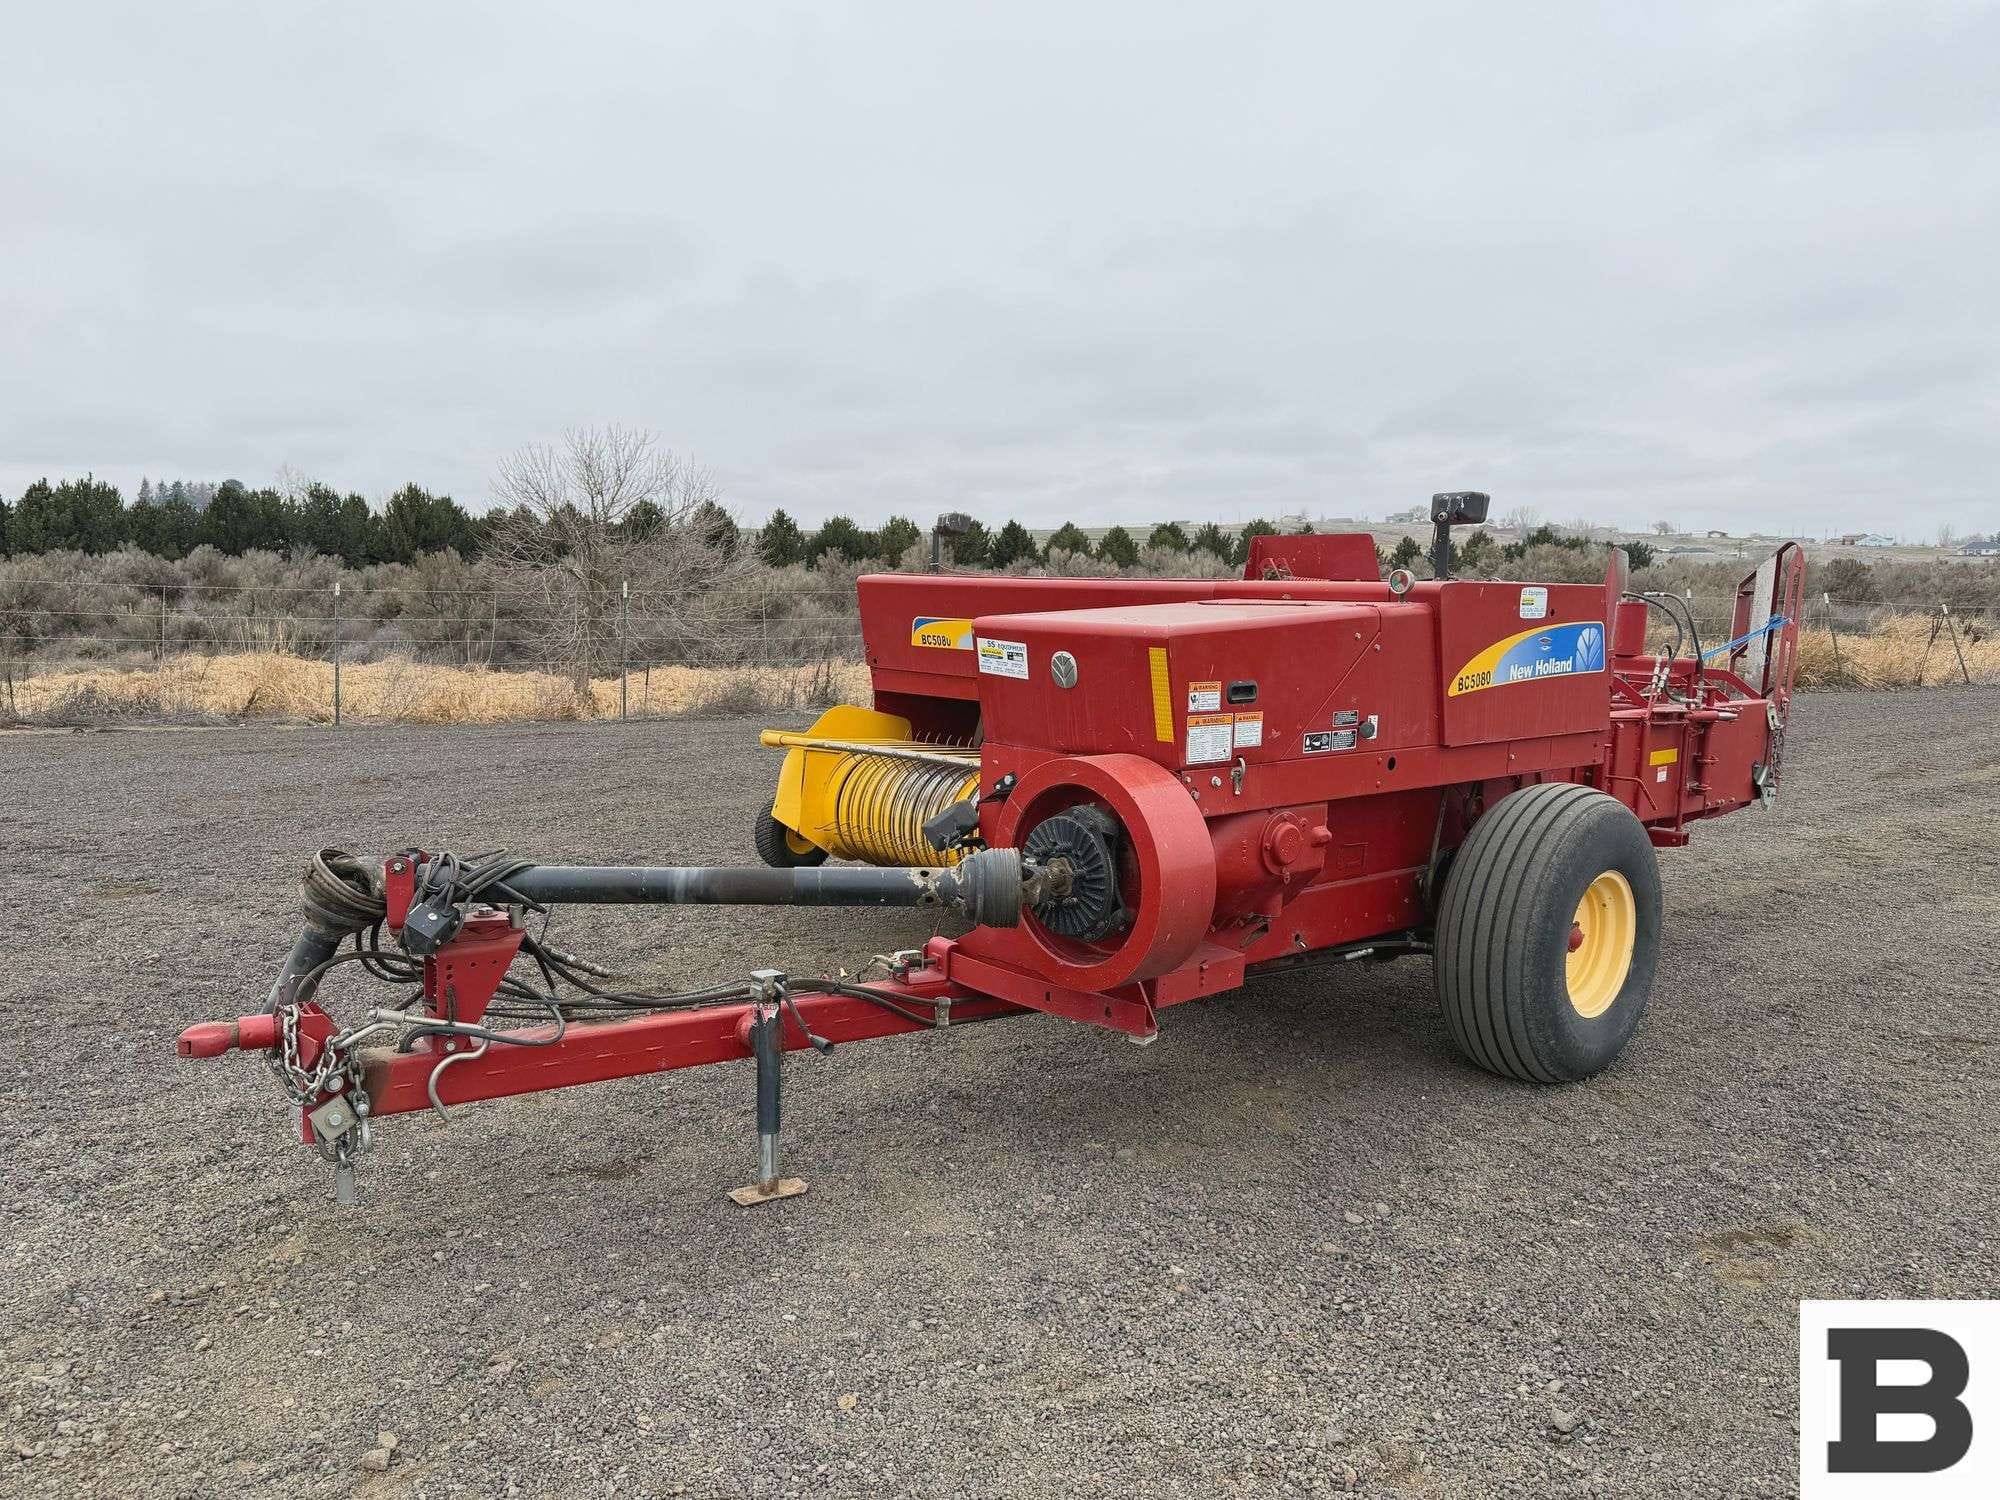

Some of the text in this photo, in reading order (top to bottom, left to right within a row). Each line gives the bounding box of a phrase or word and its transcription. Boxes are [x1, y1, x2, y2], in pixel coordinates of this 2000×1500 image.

[1509, 656, 1572, 681] New Holland
[1458, 671, 1491, 692] BC5080
